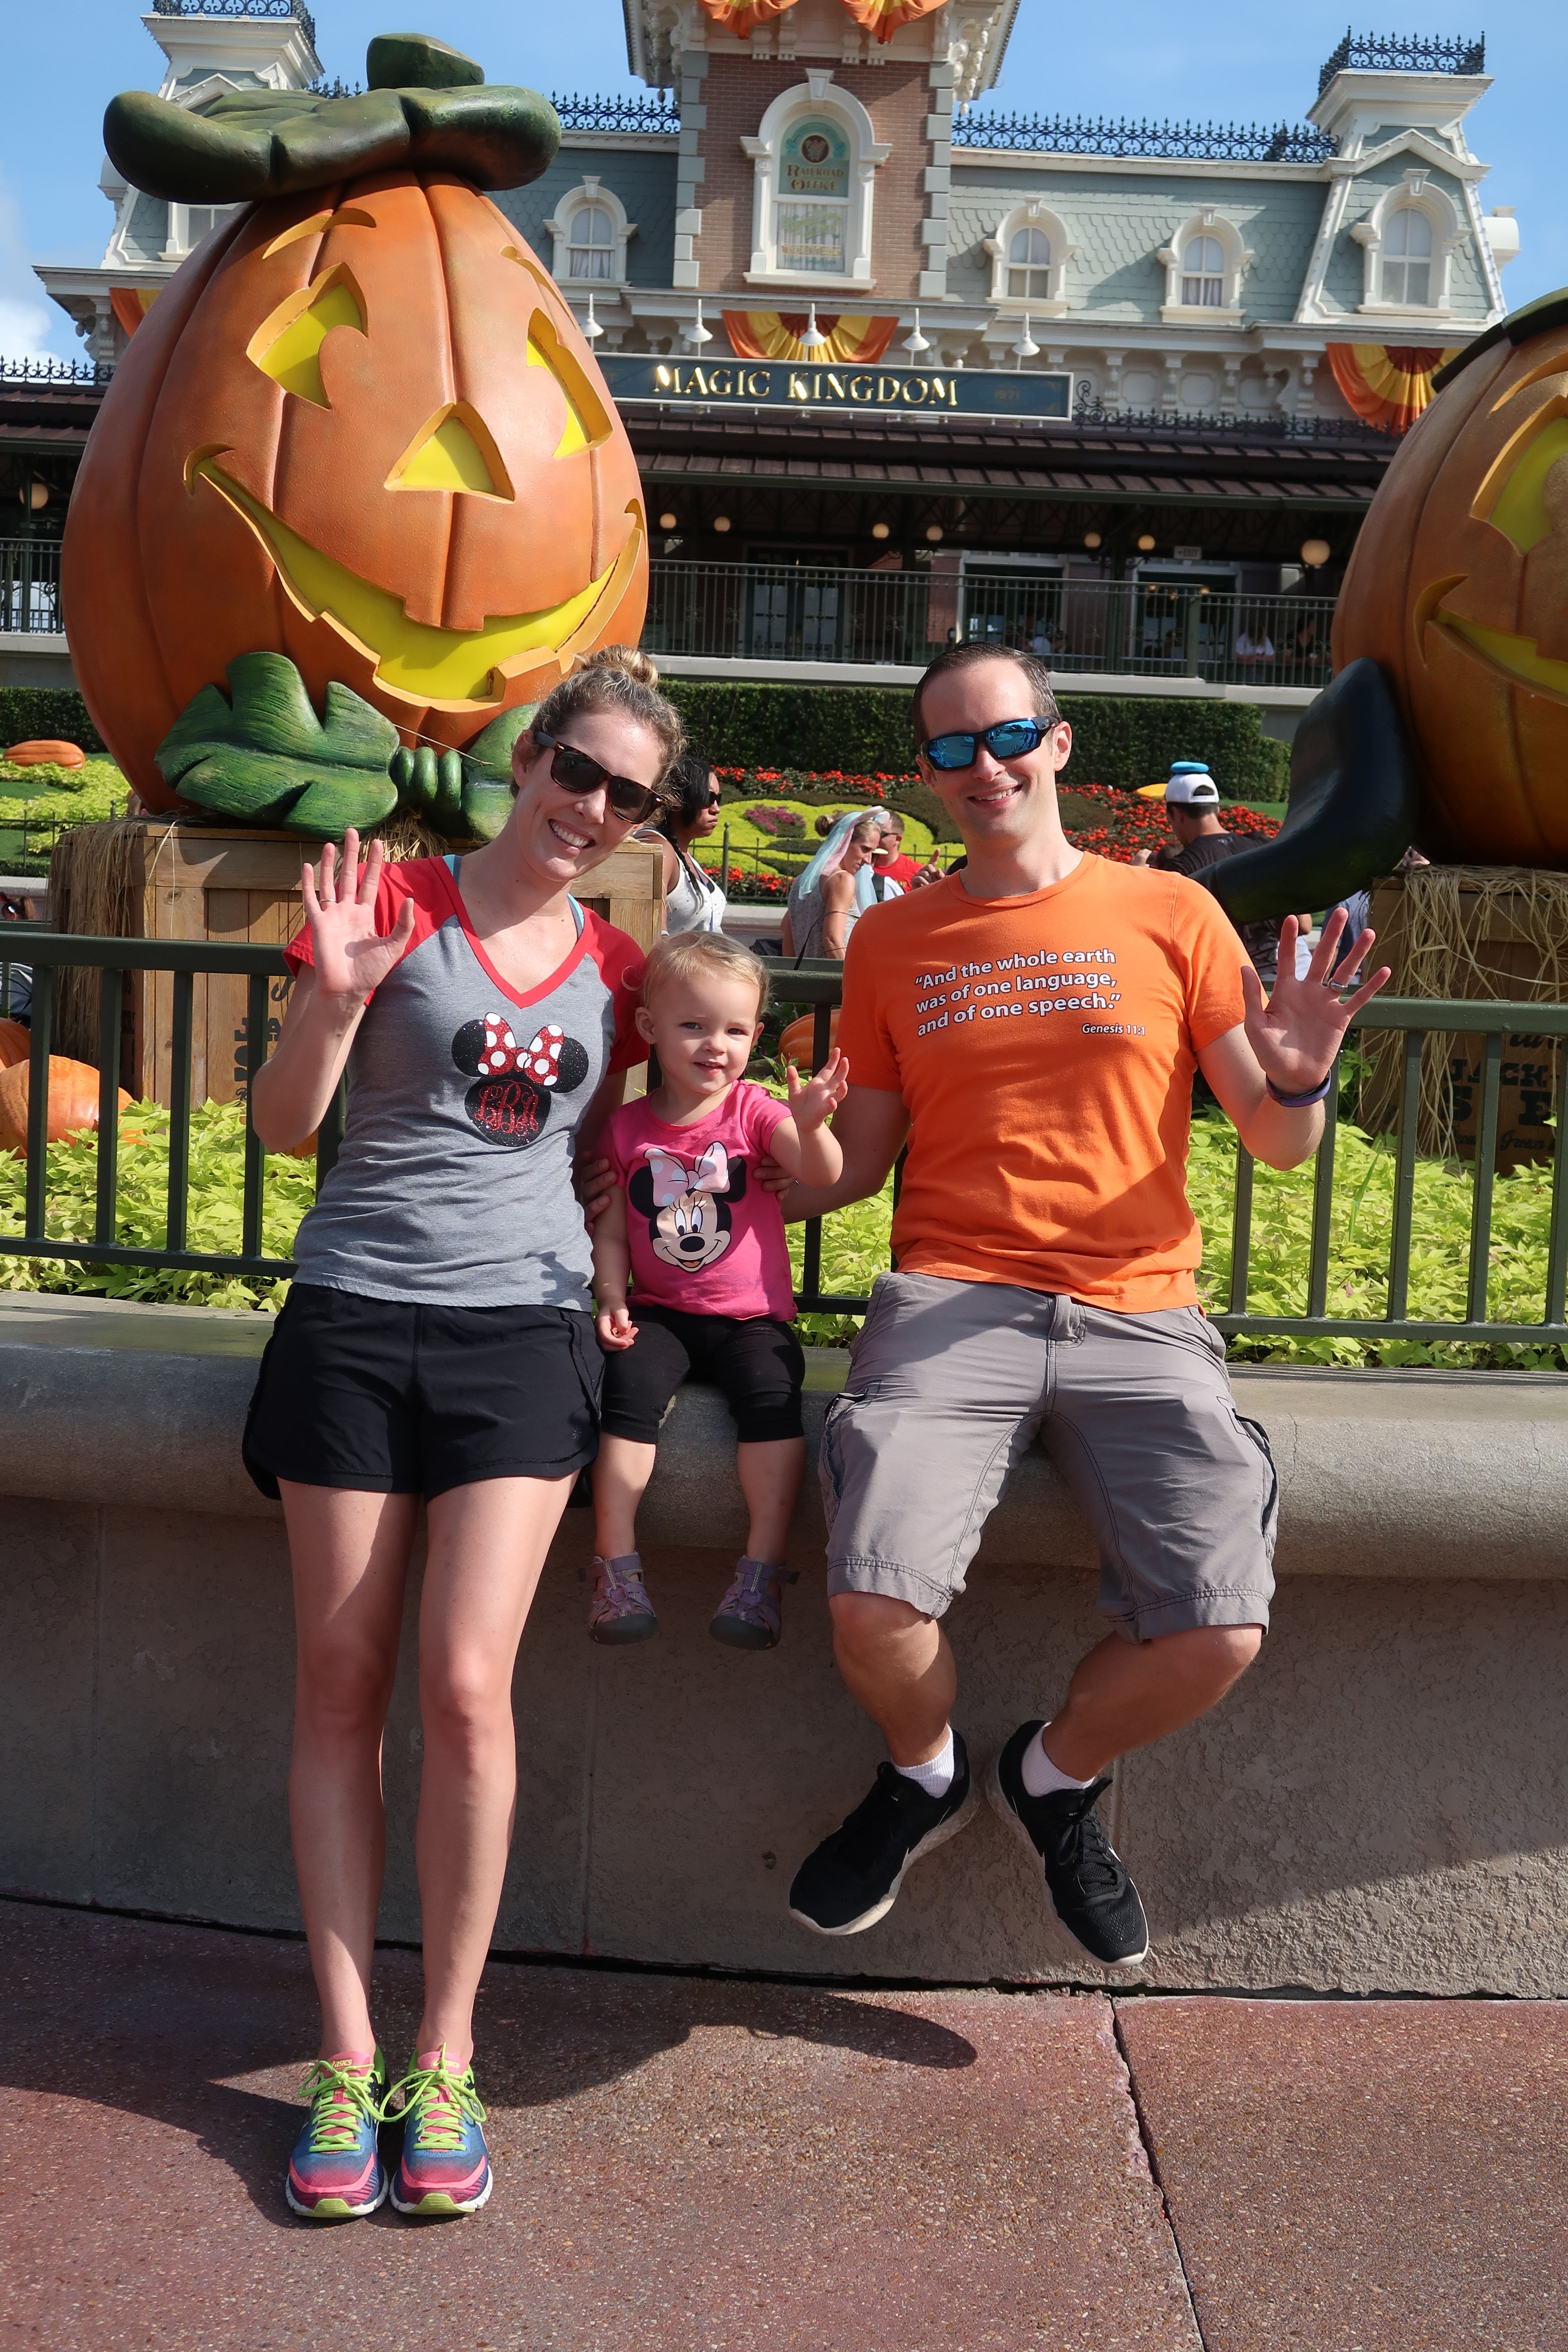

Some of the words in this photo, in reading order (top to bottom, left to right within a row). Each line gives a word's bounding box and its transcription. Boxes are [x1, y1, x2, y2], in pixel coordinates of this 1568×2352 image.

[791, 178, 838, 190] OFFICE
[653, 364, 771, 397] MAGIC
[787, 371, 959, 406] KINGDOM
[961, 962, 992, 978] the
[997, 949, 1058, 971] whole
[1063, 948, 1116, 964] earth
[916, 993, 946, 1014] was
[951, 983, 969, 1001] of
[974, 981, 1011, 998] one
[1016, 972, 1117, 992] language,
[918, 1012, 948, 1037] and
[953, 1003, 975, 1023] of
[980, 1002, 1023, 1020] one
[1082, 1023, 1124, 1034] Genesis
[1126, 1024, 1145, 1036] 11:1
